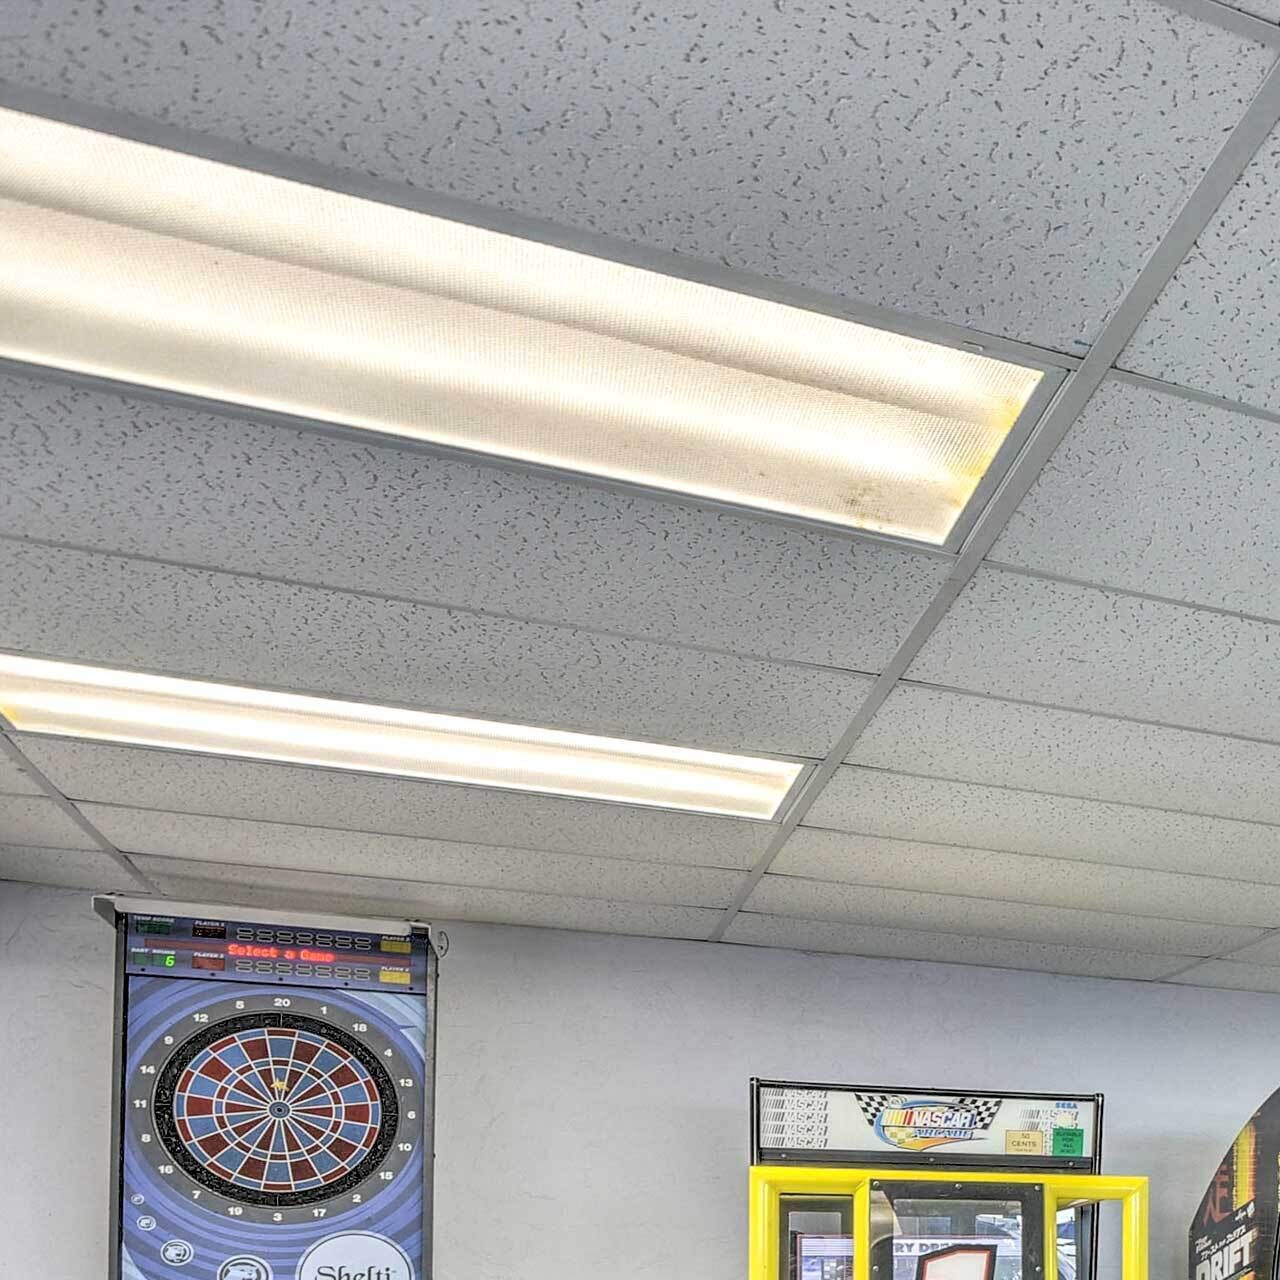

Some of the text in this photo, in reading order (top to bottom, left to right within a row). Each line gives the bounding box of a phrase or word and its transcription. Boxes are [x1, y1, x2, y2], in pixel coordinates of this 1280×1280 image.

[228, 943, 336, 963] Select a Game
[164, 955, 175, 968] 6
[235, 1001, 245, 1009] 5
[274, 998, 291, 1007] 20
[320, 1006, 328, 1014] 1
[193, 1013, 209, 1023] 12
[353, 1023, 368, 1032] 18
[164, 1036, 174, 1045] 9
[384, 1049, 393, 1057] 4
[139, 1065, 156, 1075] 14
[399, 1078, 414, 1087] 13
[133, 1100, 148, 1109] 11
[1055, 1101, 1078, 1109] SEGA
[407, 1111, 417, 1120] 6
[911, 1108, 977, 1129] NASCAR
[141, 1134, 152, 1143] 8
[398, 1143, 413, 1152] 10
[1011, 1140, 1037, 1148] CENTS
[158, 1165, 174, 1174] 16
[379, 1171, 394, 1181] 15
[192, 1190, 201, 1199] 7
[352, 1194, 362, 1203] 2
[227, 1206, 243, 1216] 19
[312, 1208, 327, 1217] 17
[273, 1213, 283, 1222] 3
